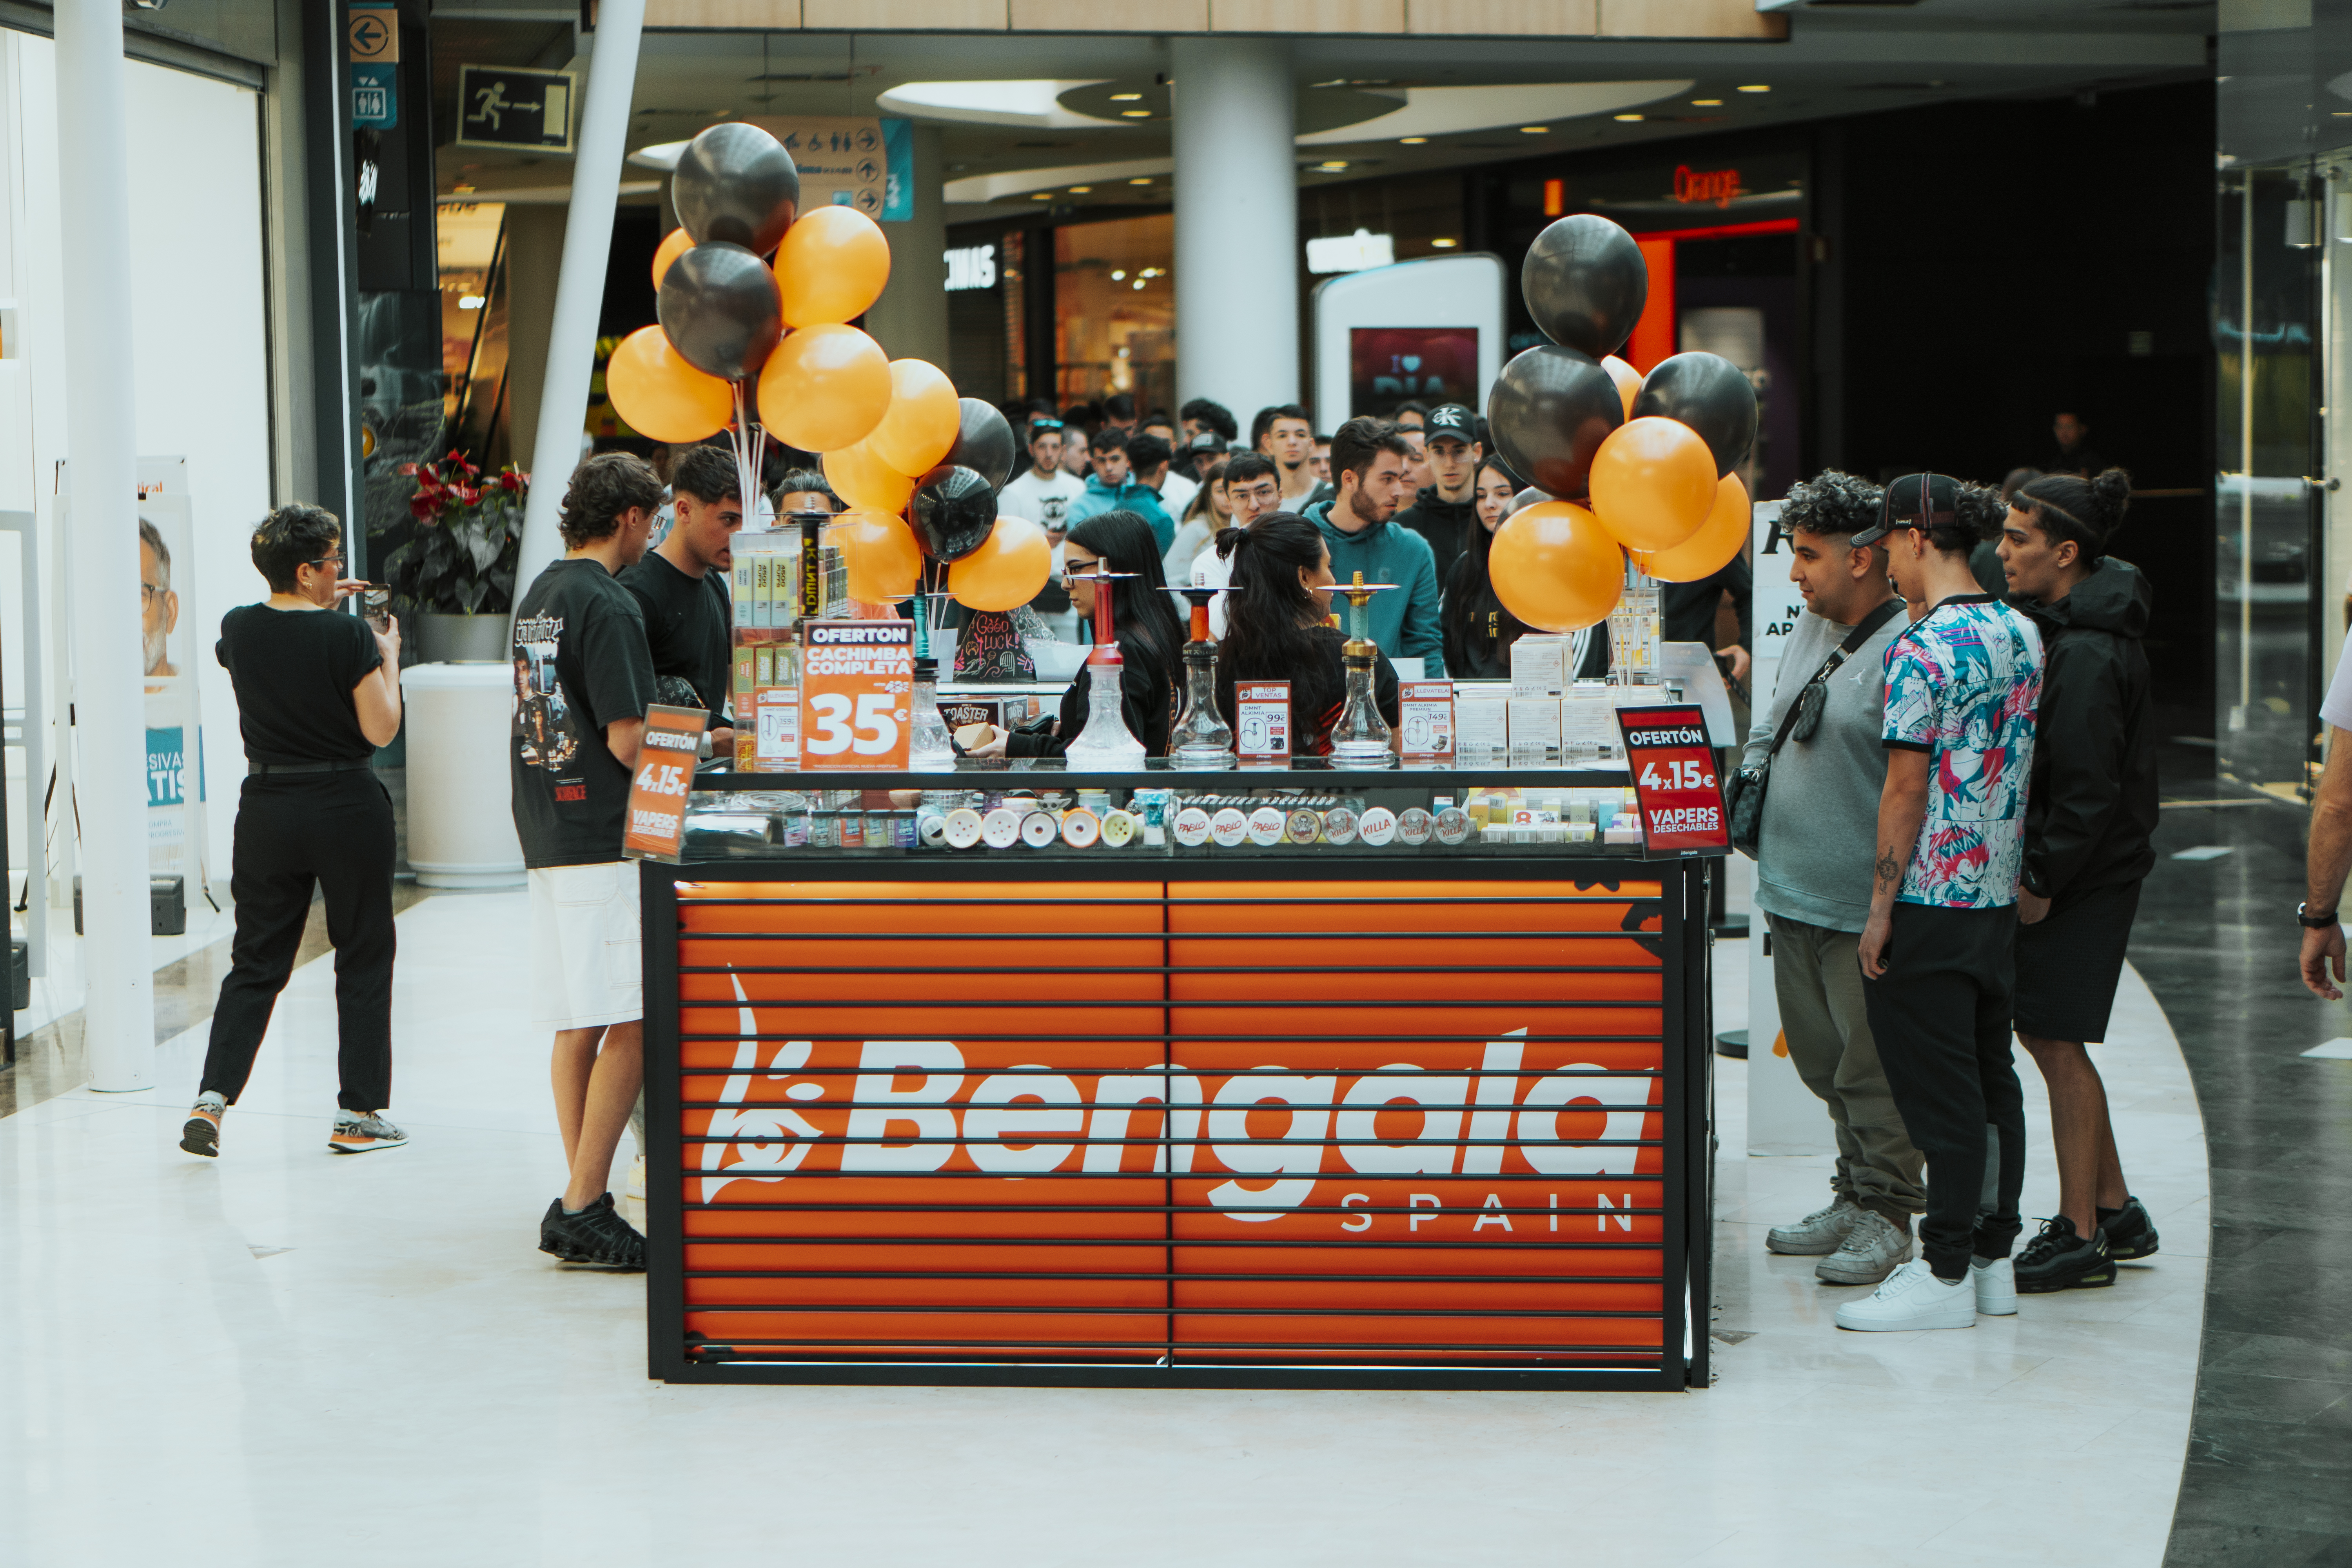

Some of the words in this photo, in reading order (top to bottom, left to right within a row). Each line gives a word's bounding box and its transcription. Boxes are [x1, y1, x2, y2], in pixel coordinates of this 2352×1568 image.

[1674, 164, 1740, 209] Orange
[813, 628, 907, 642] OFERTON
[984, 632, 1020, 650] LUCK!
[807, 648, 911, 661] CACHIMBA
[806, 661, 911, 675] COMPLETA
[944, 707, 988, 721] TOASTER
[1007, 705, 1023, 720] TOASTER
[646, 731, 698, 750] OFERTÓN
[1630, 727, 1703, 745] OFERTÓN
[633, 809, 679, 830] VAPERS
[1649, 807, 1718, 825] VAPERS
[632, 824, 675, 838] DESECHABLES
[1178, 821, 1205, 834] PABLO
[1215, 820, 1241, 835] PABLO
[1252, 821, 1280, 833] PABLO
[1332, 825, 1351, 838] KILLA
[1363, 819, 1392, 836] KILLA
[1405, 827, 1425, 837] KILLA
[1443, 827, 1462, 837] KILLA
[1653, 822, 1718, 833] DESECHABLES
[840, 1026, 1654, 1222] Bengala
[1339, 1192, 1632, 1232] SPAIN
